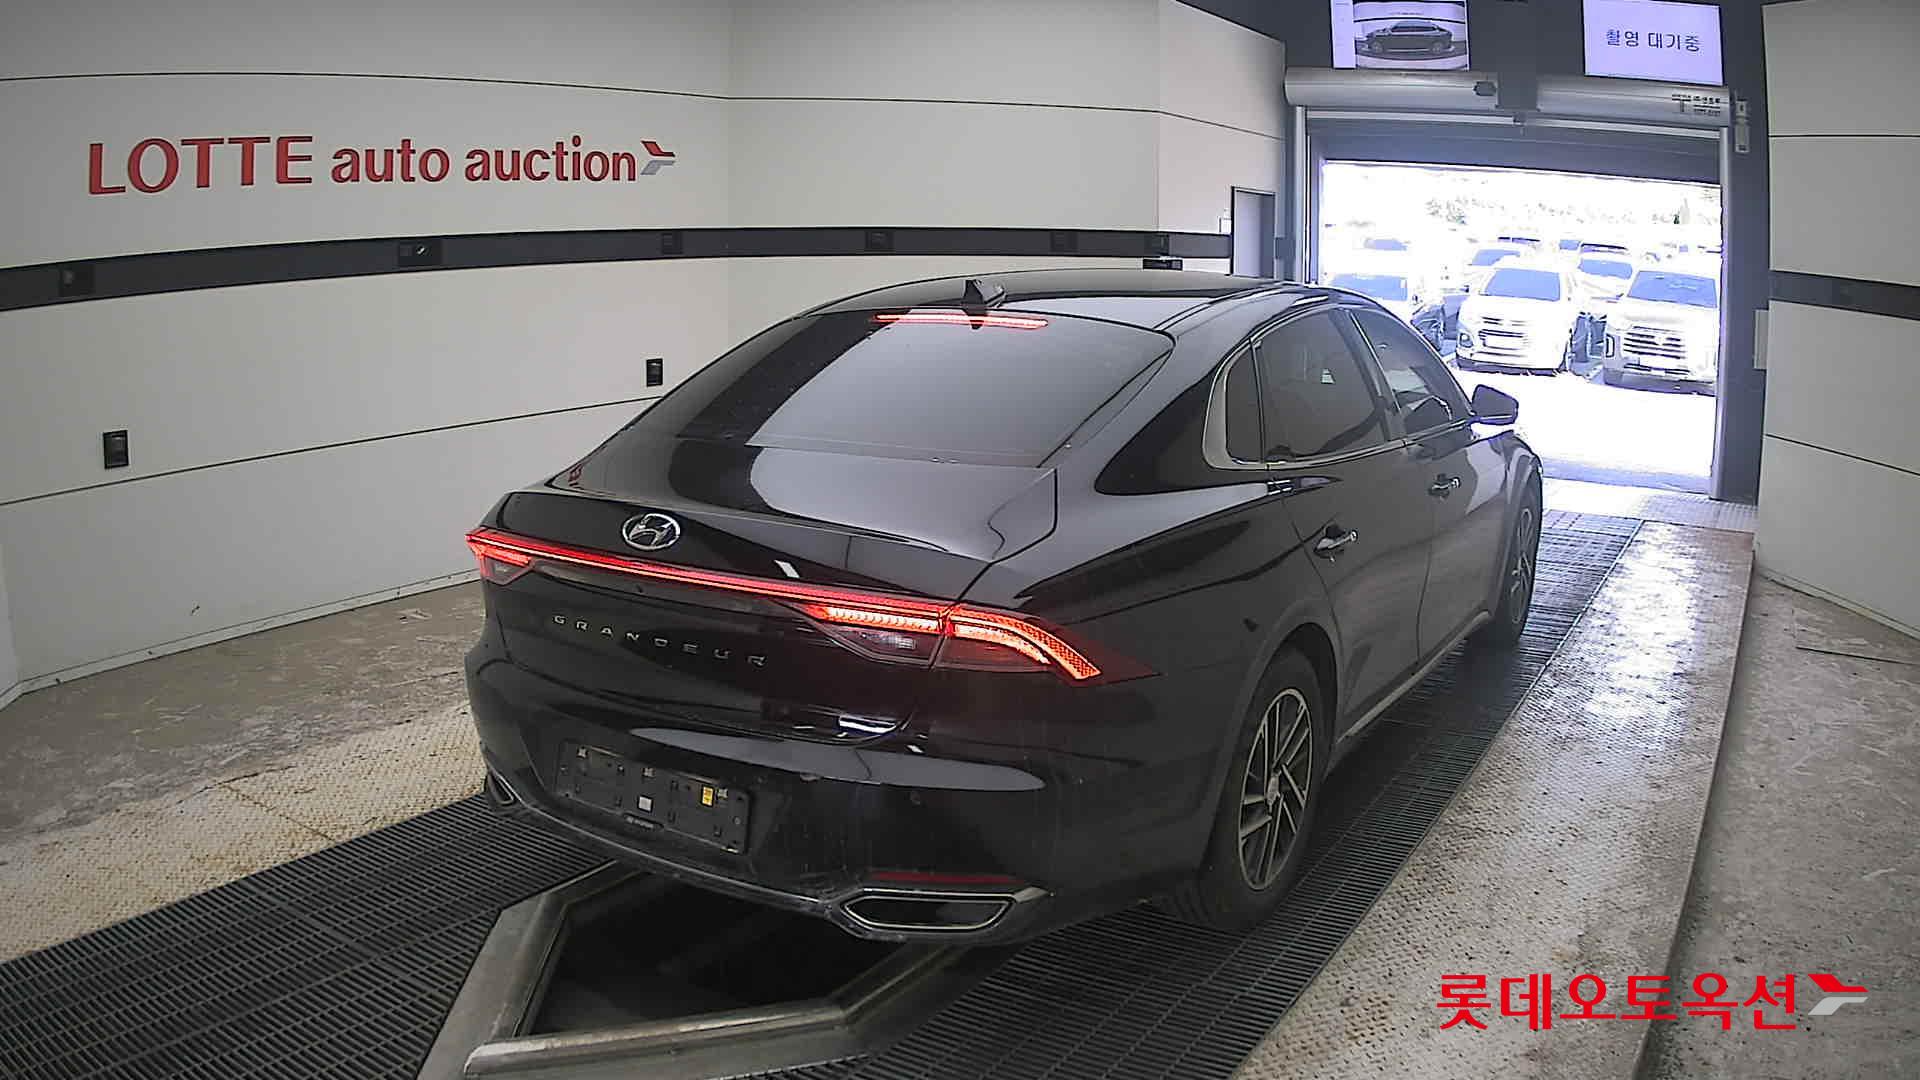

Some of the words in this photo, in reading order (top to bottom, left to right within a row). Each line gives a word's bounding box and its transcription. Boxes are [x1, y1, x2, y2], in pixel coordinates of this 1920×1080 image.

[1648, 32, 1700, 52] 대기중
[89, 136, 313, 195] LOTTE
[331, 138, 450, 183] auto
[464, 135, 637, 182] auction
[553, 614, 767, 667] GRANDEUR
